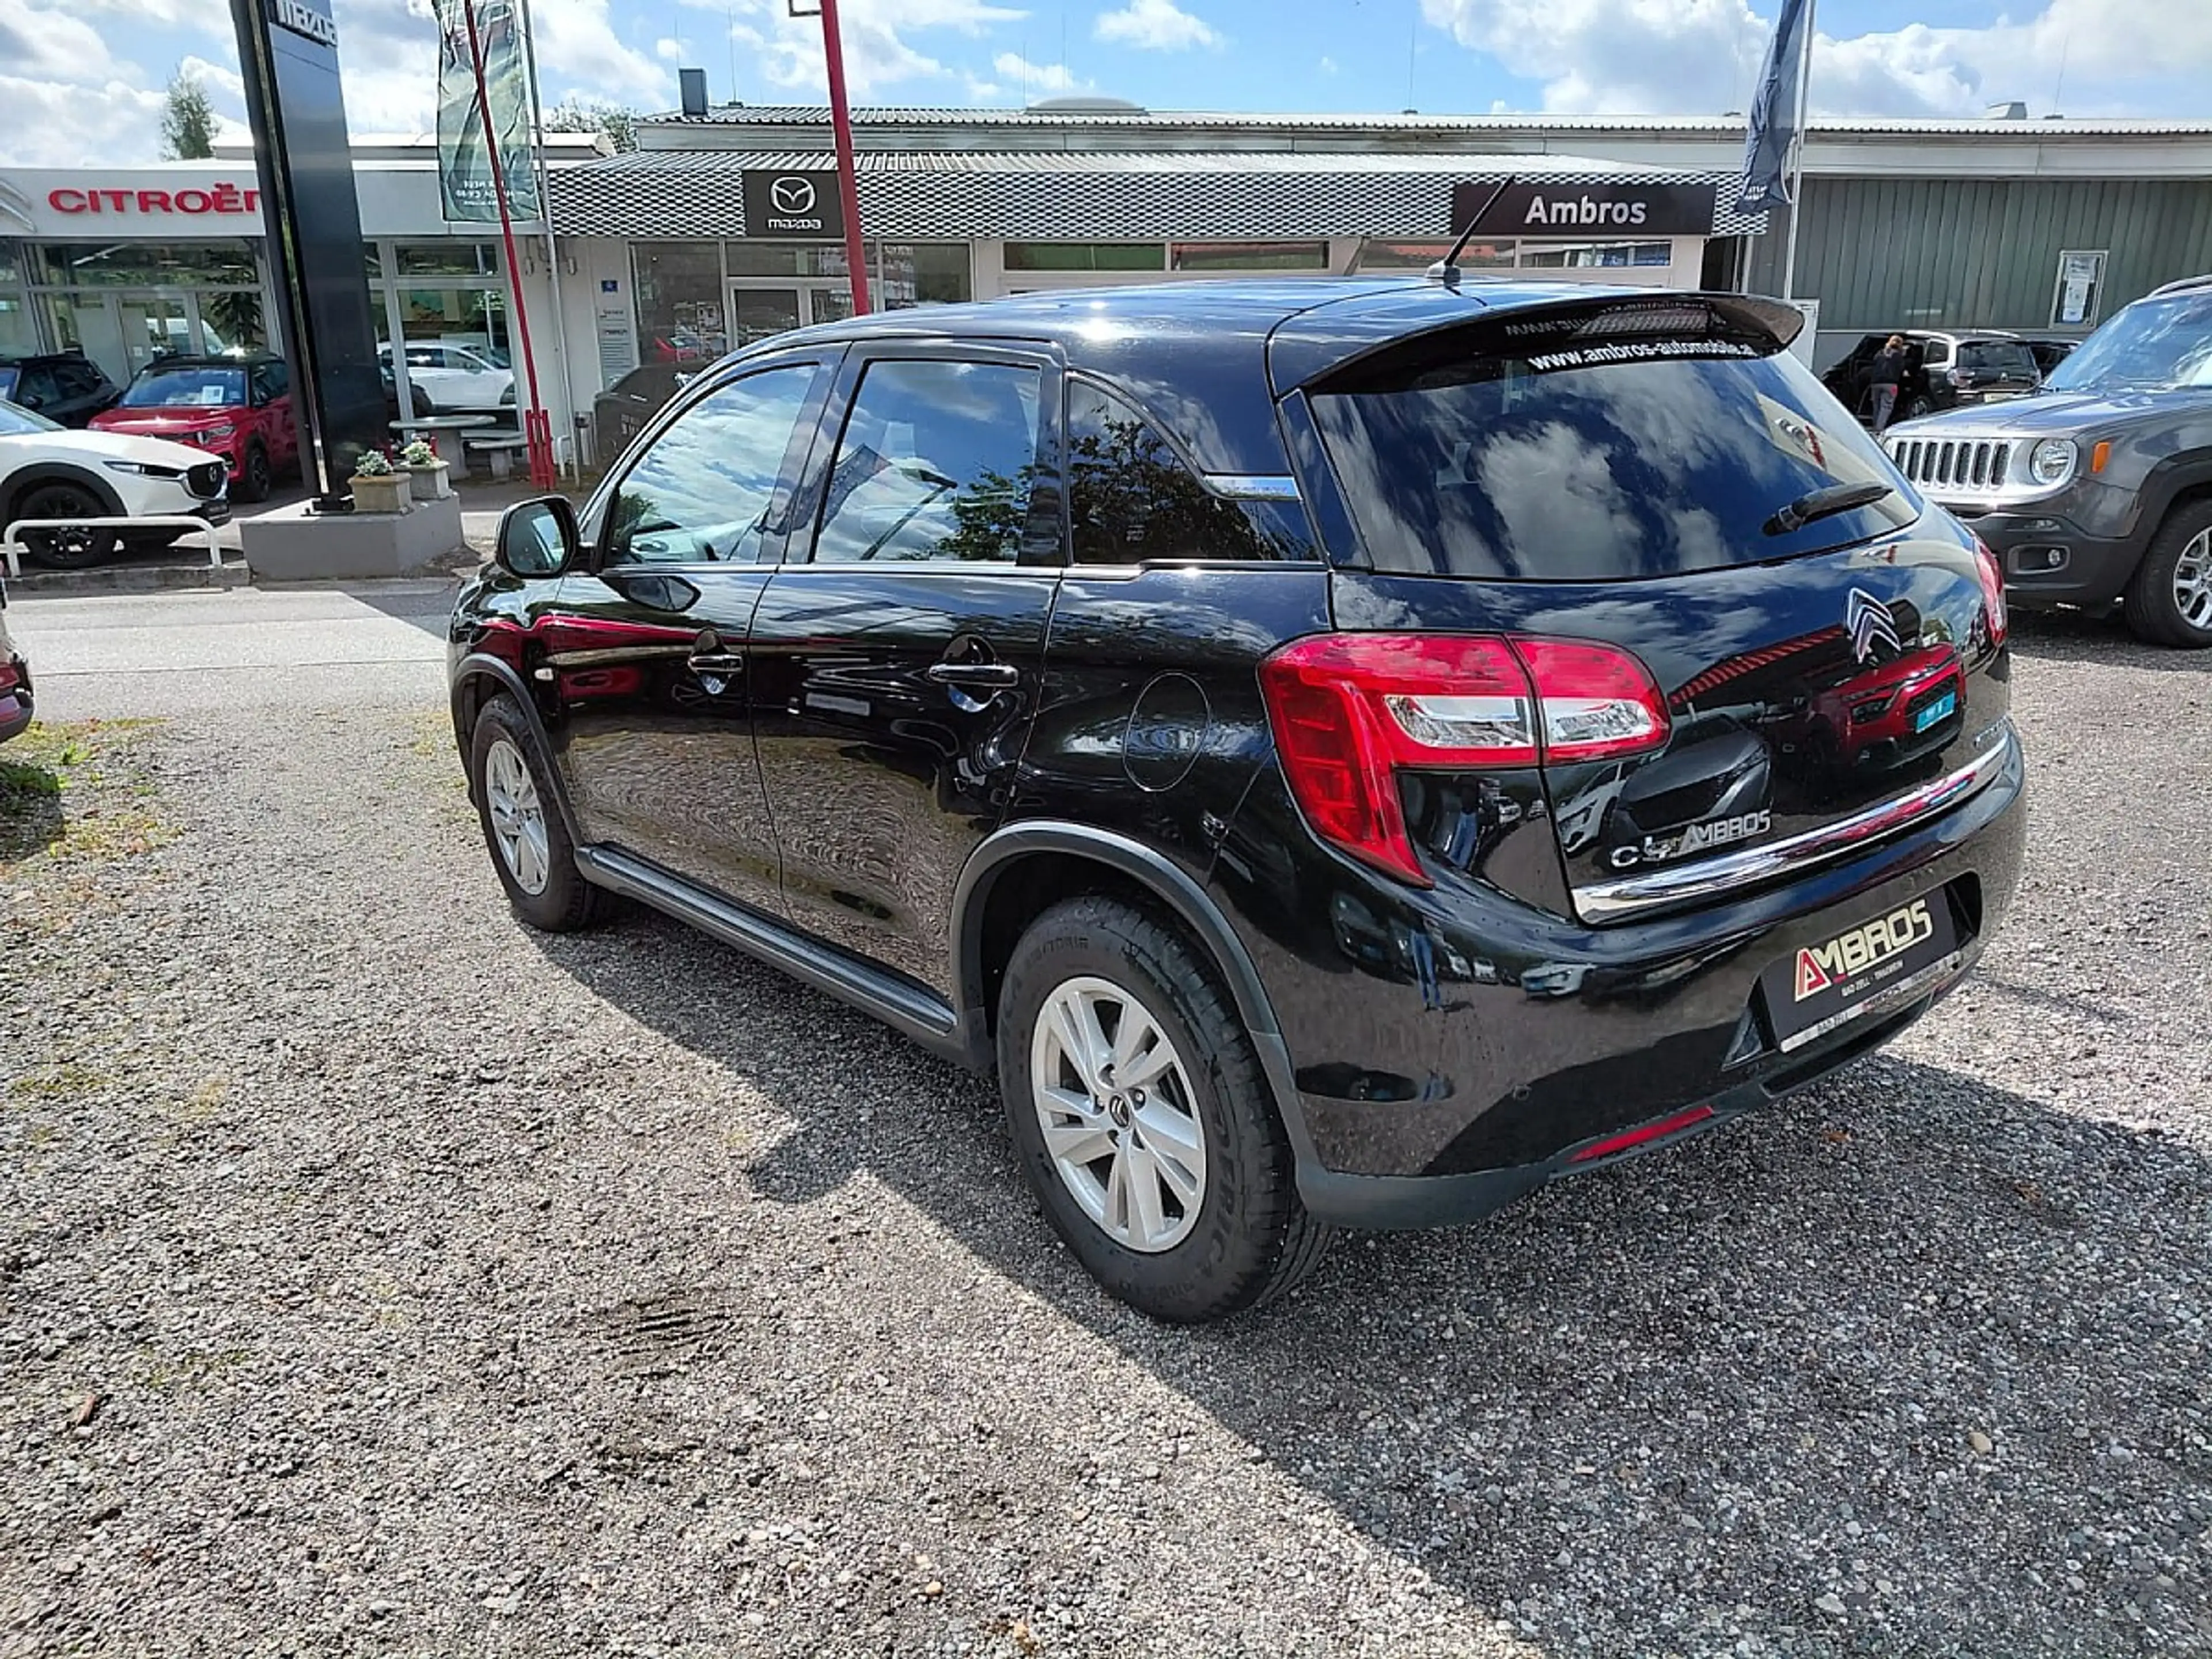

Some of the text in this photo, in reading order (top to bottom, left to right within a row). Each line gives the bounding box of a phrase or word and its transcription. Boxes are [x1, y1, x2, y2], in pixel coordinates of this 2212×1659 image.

[768, 219, 821, 230] mazda
[1524, 195, 1647, 224] Ambros
[1679, 808, 1771, 853] AMBROS
[1795, 899, 1933, 1002] AMBROS
